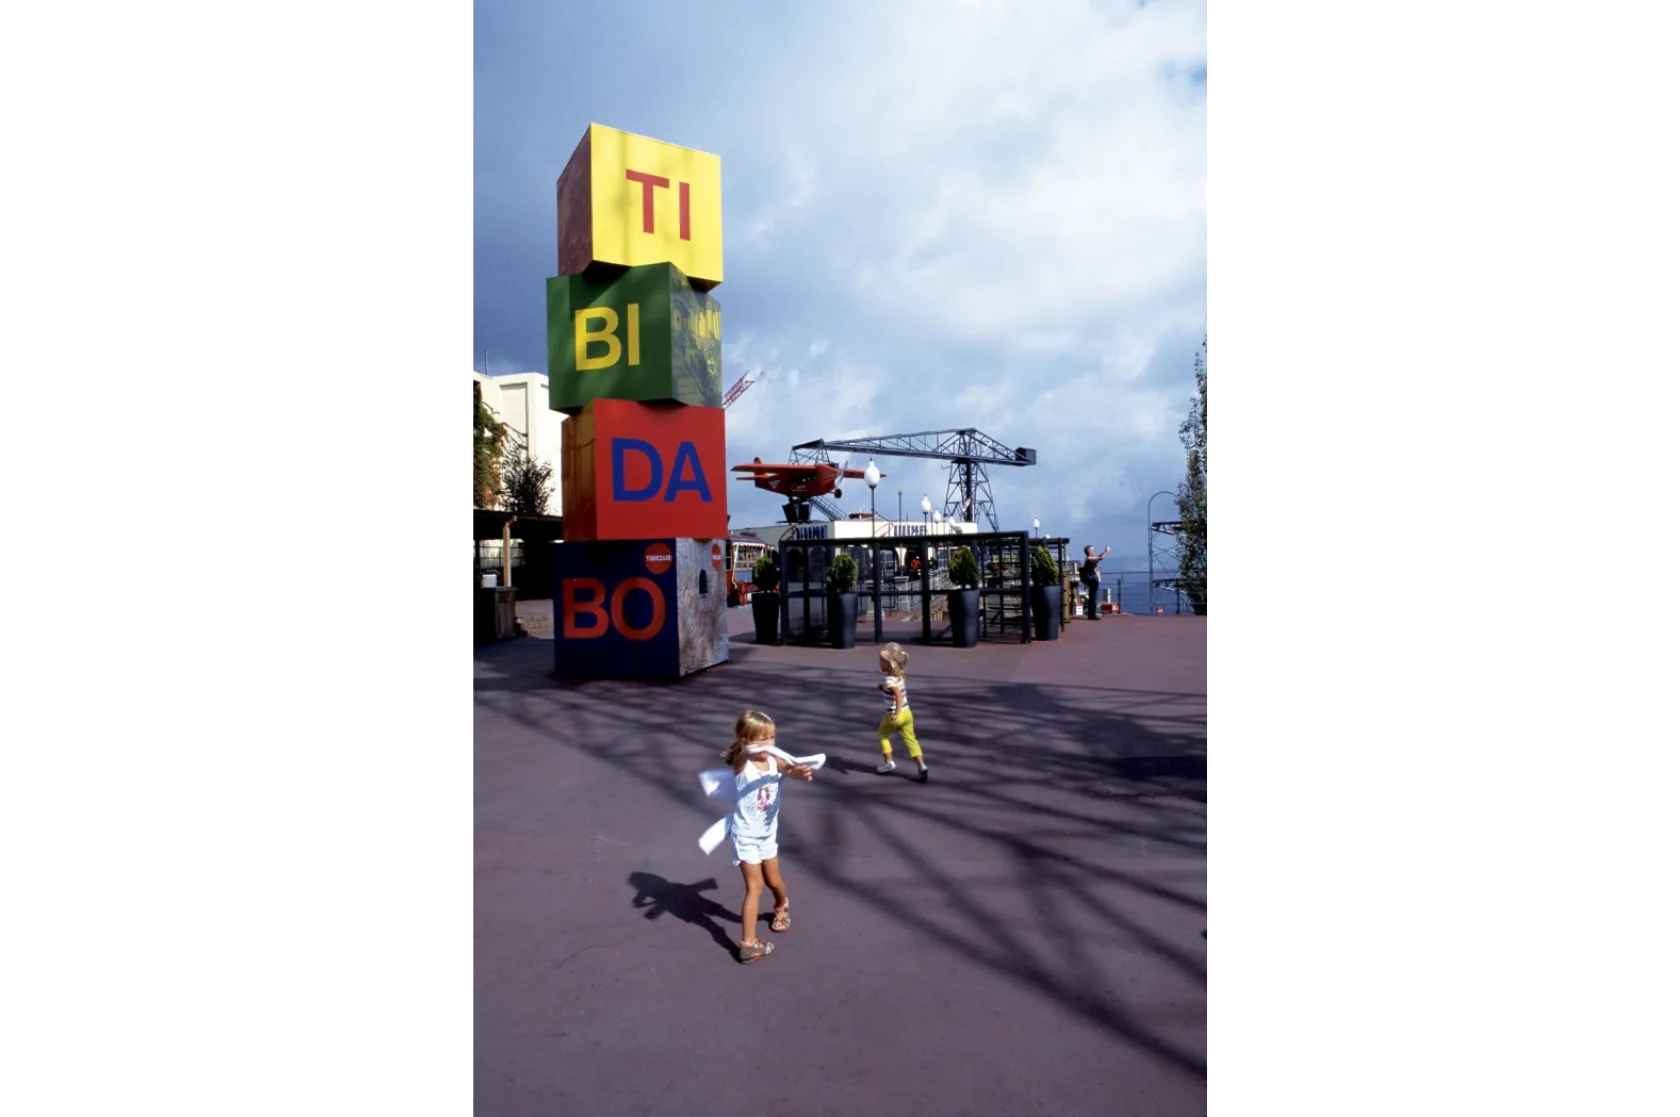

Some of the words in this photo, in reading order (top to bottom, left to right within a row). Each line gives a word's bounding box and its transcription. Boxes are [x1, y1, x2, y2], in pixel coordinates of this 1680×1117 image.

[626, 169, 691, 240] TI
[575, 303, 640, 371] BI
[611, 438, 712, 502] DA
[562, 578, 665, 641] BO
